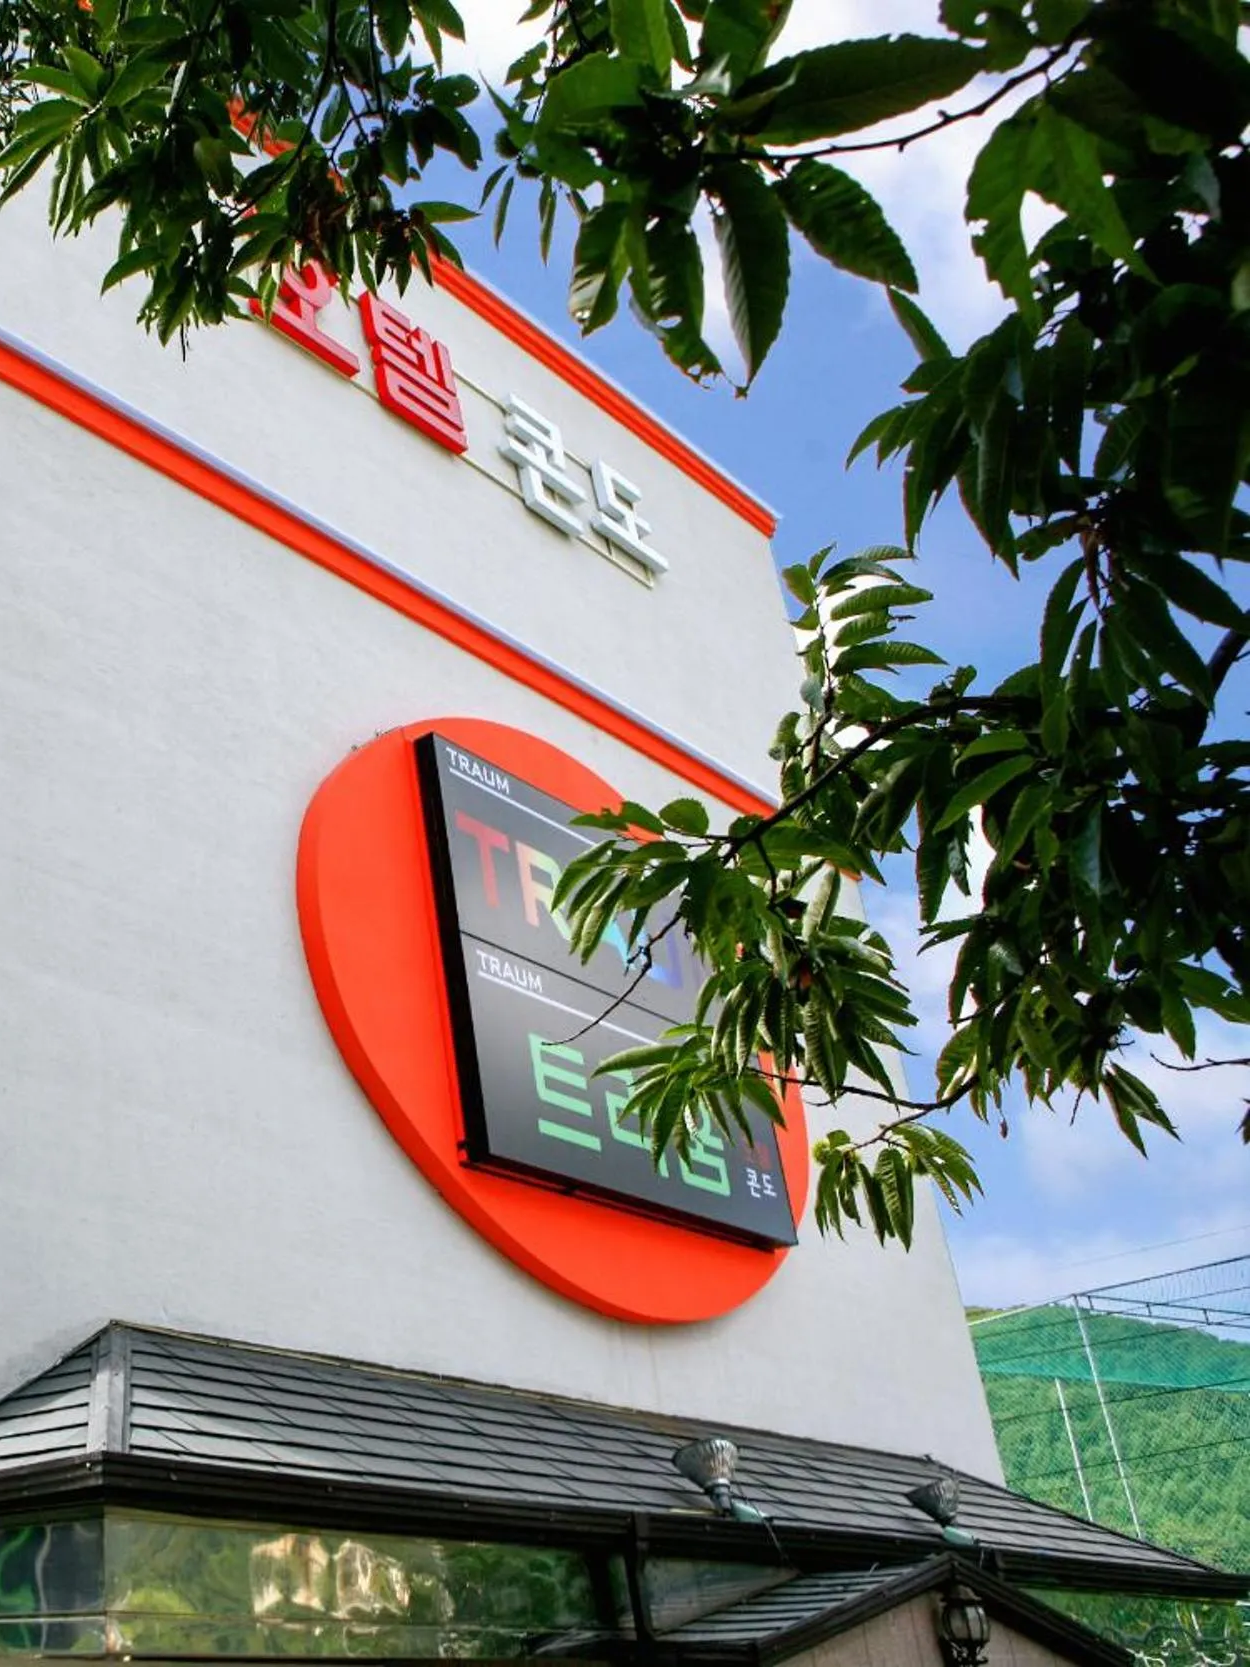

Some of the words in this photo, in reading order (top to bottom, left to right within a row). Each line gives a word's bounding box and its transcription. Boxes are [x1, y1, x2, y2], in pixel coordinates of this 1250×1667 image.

[498, 393, 669, 573] 콘도
[446, 746, 510, 795] TRAUM
[476, 948, 543, 993] TRAUM
[745, 1166, 778, 1199] 콘도
